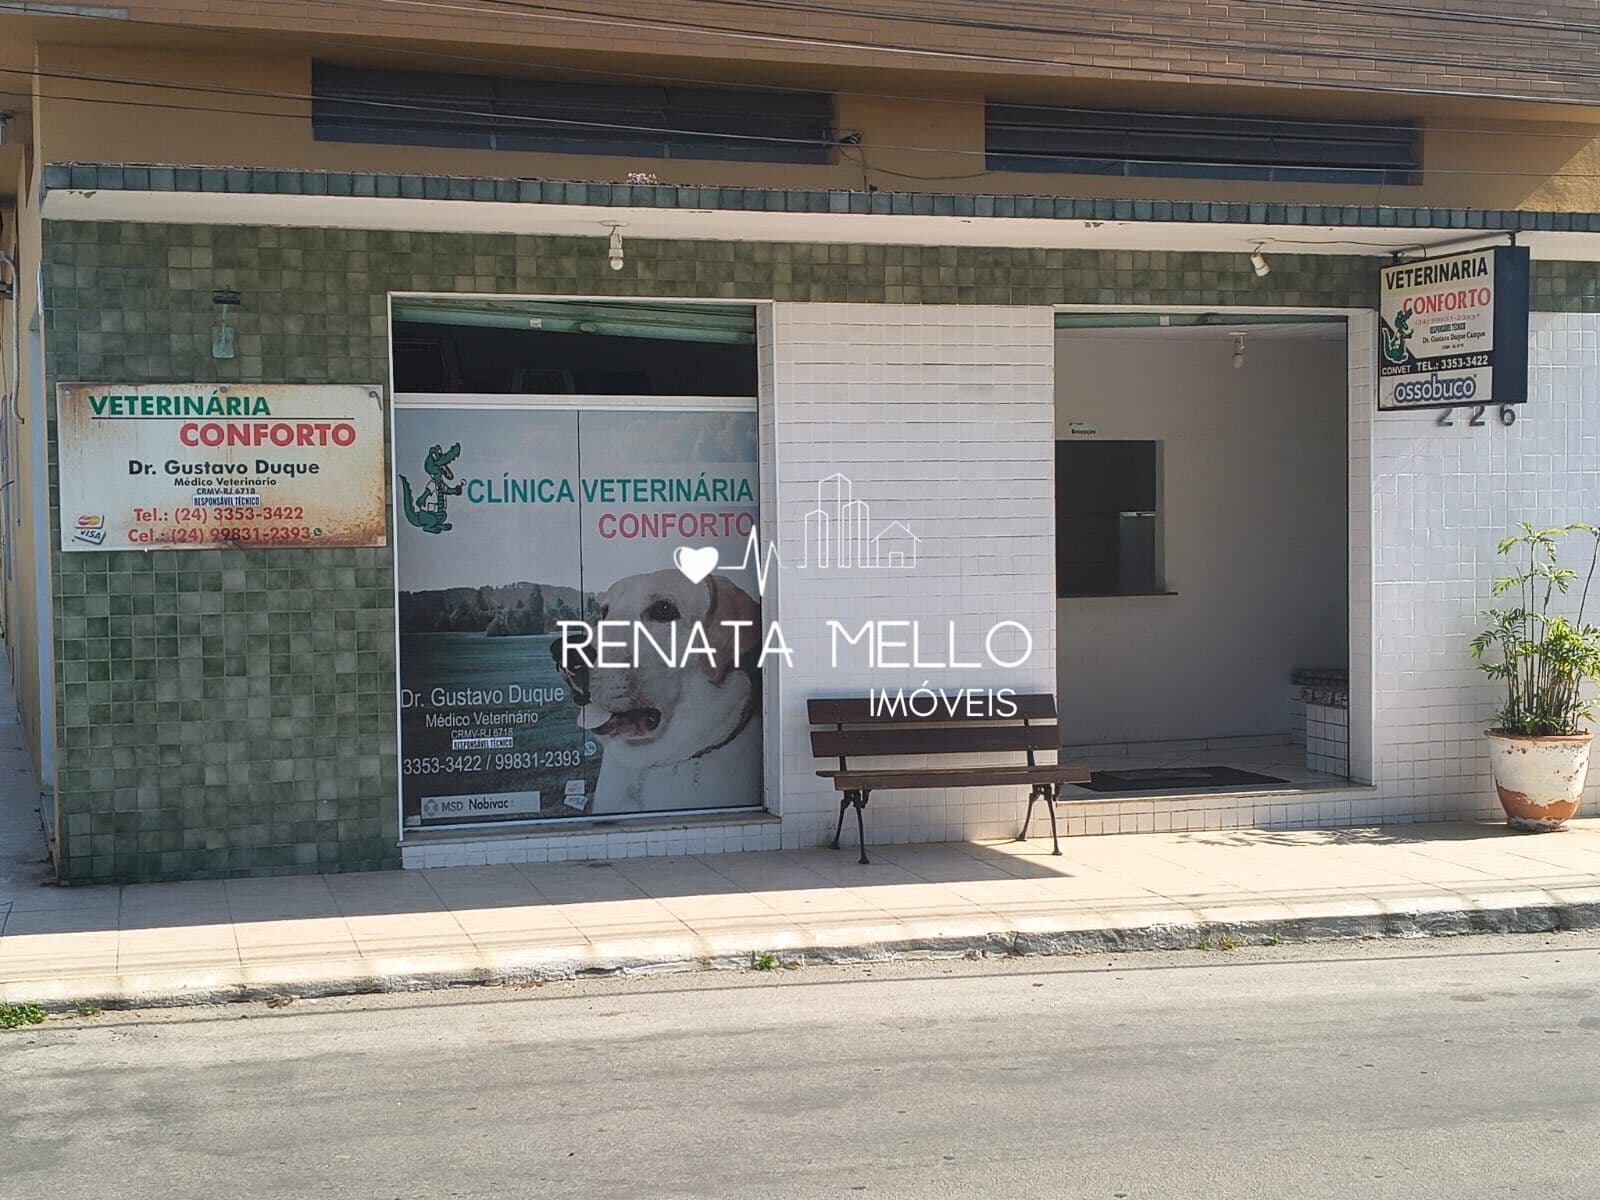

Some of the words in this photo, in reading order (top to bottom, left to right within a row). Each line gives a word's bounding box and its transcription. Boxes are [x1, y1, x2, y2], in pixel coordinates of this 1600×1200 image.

[1386, 256, 1488, 290] VETERINARIA
[1403, 287, 1491, 316] CONFORTO
[1382, 364, 1411, 376] CONVET
[1416, 361, 1439, 373] TEL.:
[1441, 355, 1489, 370] 3353-3422
[1395, 374, 1476, 403] ossobuco
[88, 390, 271, 416] VETERINÁRIA
[180, 422, 356, 447] CONFORTO
[128, 460, 156, 475] Dr.
[164, 460, 248, 476] Gustavo
[255, 459, 320, 479] Duque
[174, 477, 213, 487] Médico
[217, 476, 277, 487] Veterinário
[466, 472, 575, 504] CLÍNICA
[581, 472, 754, 503] VETERINÁRIA
[194, 495, 234, 506] RESPONSÁVEL
[235, 495, 260, 506] TÉCNICO
[133, 508, 168, 521] Tel.:
[175, 507, 207, 524] (24)
[214, 507, 304, 522] 3353-3422
[598, 512, 756, 539] CONFORTO
[128, 528, 164, 542] Cel.:
[171, 527, 204, 544] (24)
[210, 527, 311, 542] 99831-2393
[401, 689, 424, 708] Dr.
[431, 687, 503, 706] Gustavo
[509, 684, 565, 706] Duque
[425, 712, 471, 728] Médico
[473, 711, 539, 726] Veterinário
[403, 755, 482, 775] 3353-3422
[495, 750, 581, 770] 99831-2393
[441, 801, 464, 812] MSD
[469, 798, 509, 811] Nobivac
